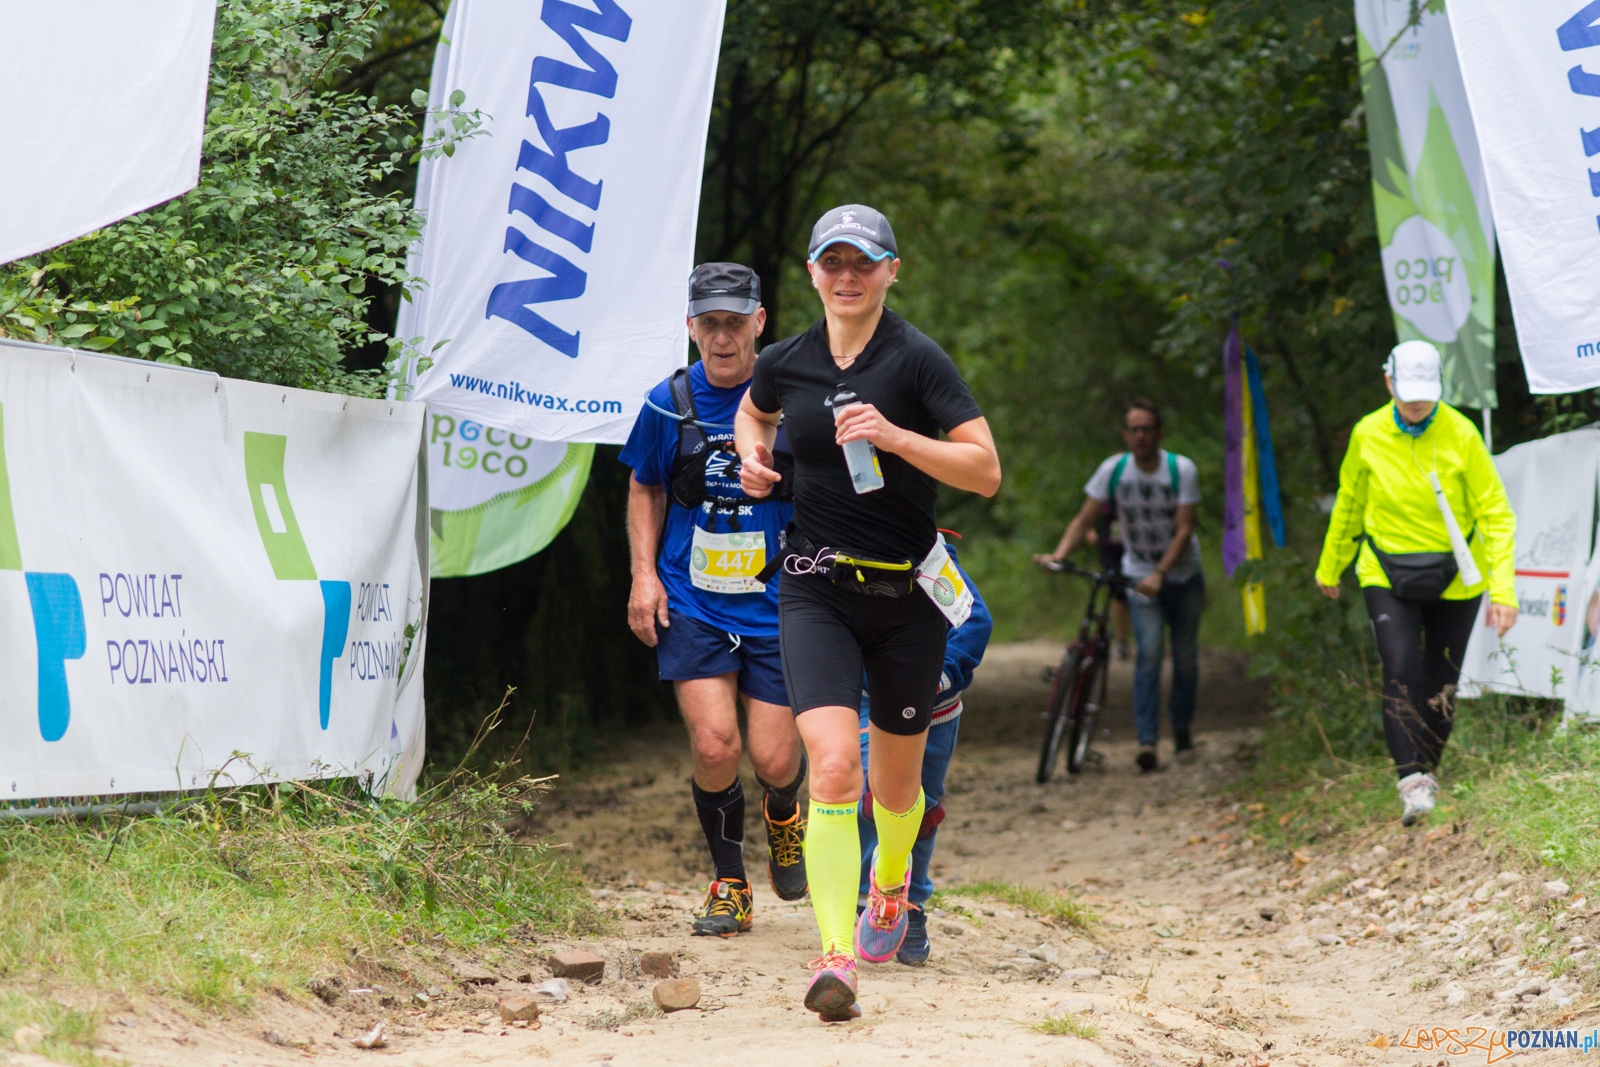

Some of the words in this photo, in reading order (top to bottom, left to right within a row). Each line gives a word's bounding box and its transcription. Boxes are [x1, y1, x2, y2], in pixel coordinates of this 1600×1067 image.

[449, 373, 622, 414] www.nikwax.com
[435, 441, 529, 478] loco
[716, 551, 757, 571] 447
[99, 572, 183, 618] POWIAT
[356, 582, 392, 622] POWIAT
[106, 628, 228, 684] POZNAŃSKI
[350, 631, 401, 680] POZNAŃ
[816, 807, 856, 816] nessi
